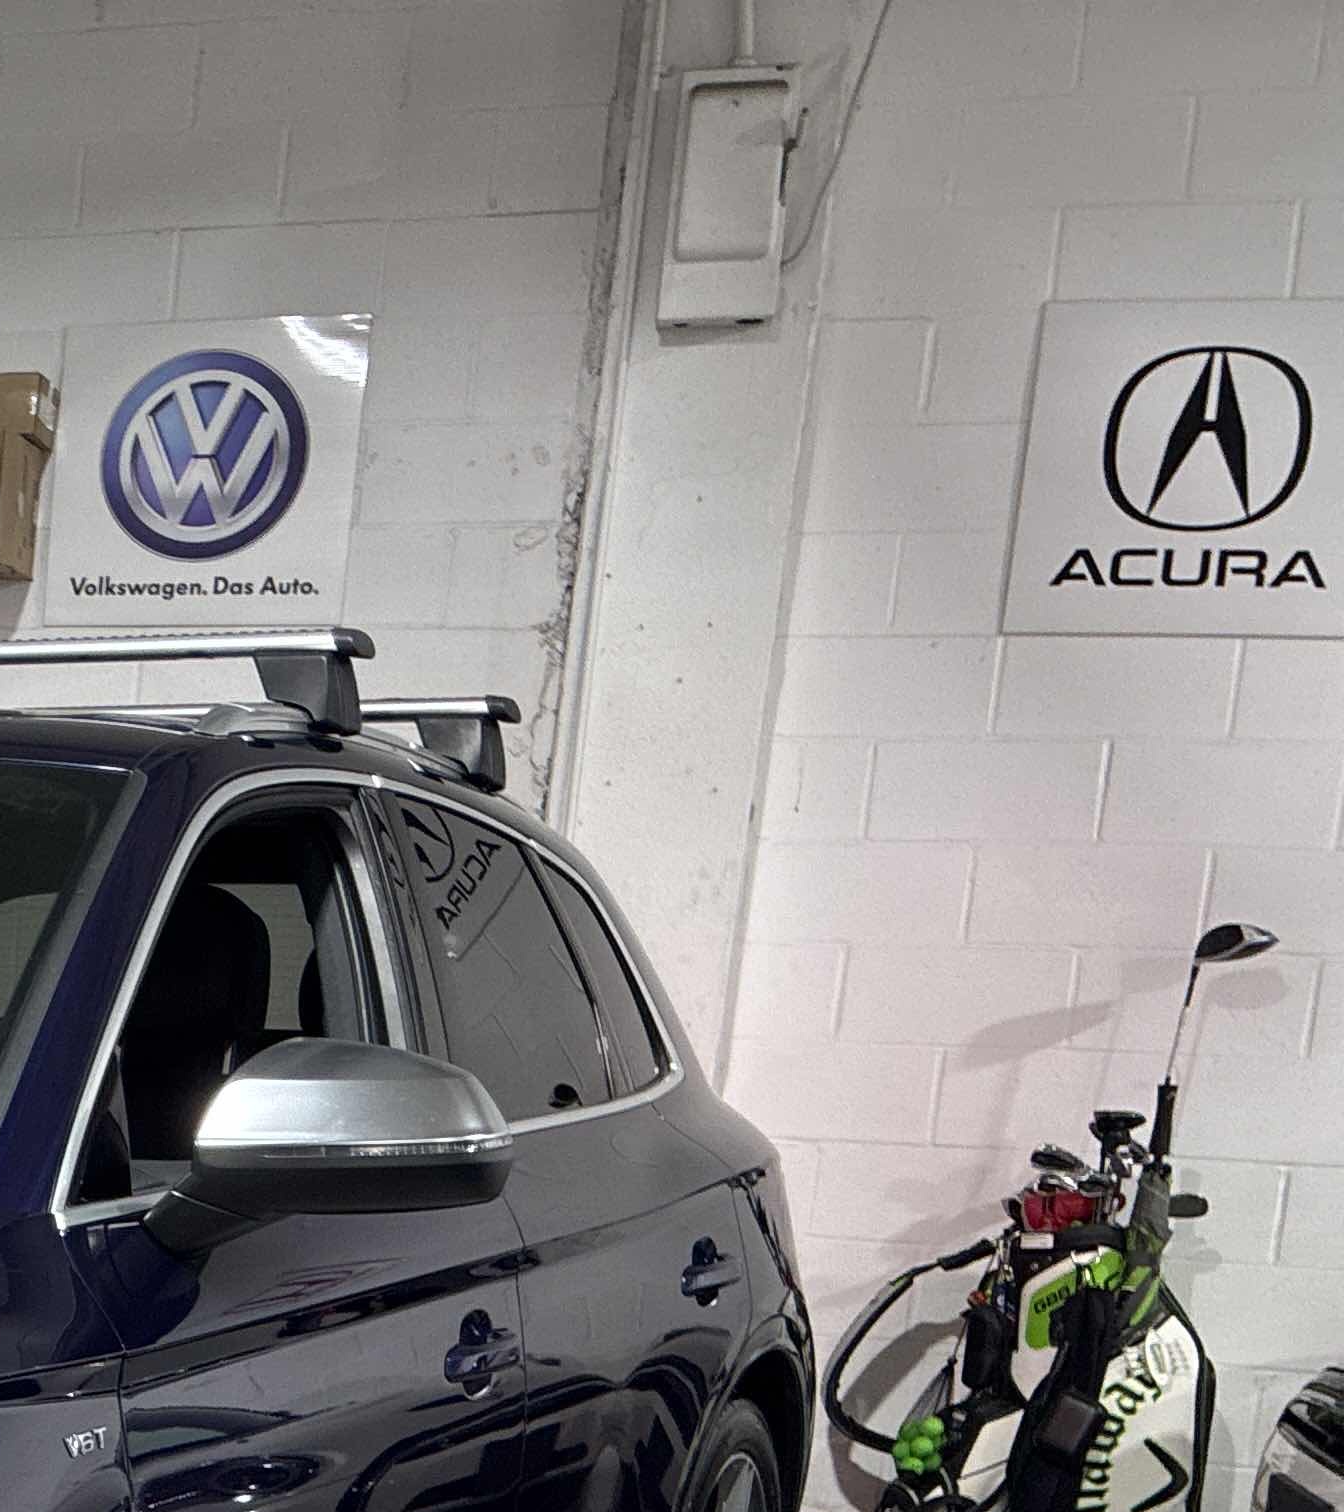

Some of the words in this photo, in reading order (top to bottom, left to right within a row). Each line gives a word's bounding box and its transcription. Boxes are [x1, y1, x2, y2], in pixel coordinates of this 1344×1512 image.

[1048, 547, 1327, 589] ACURA
[69, 575, 208, 601] Volkswagen.
[213, 575, 254, 597] Das
[259, 575, 320, 597] Auto.
